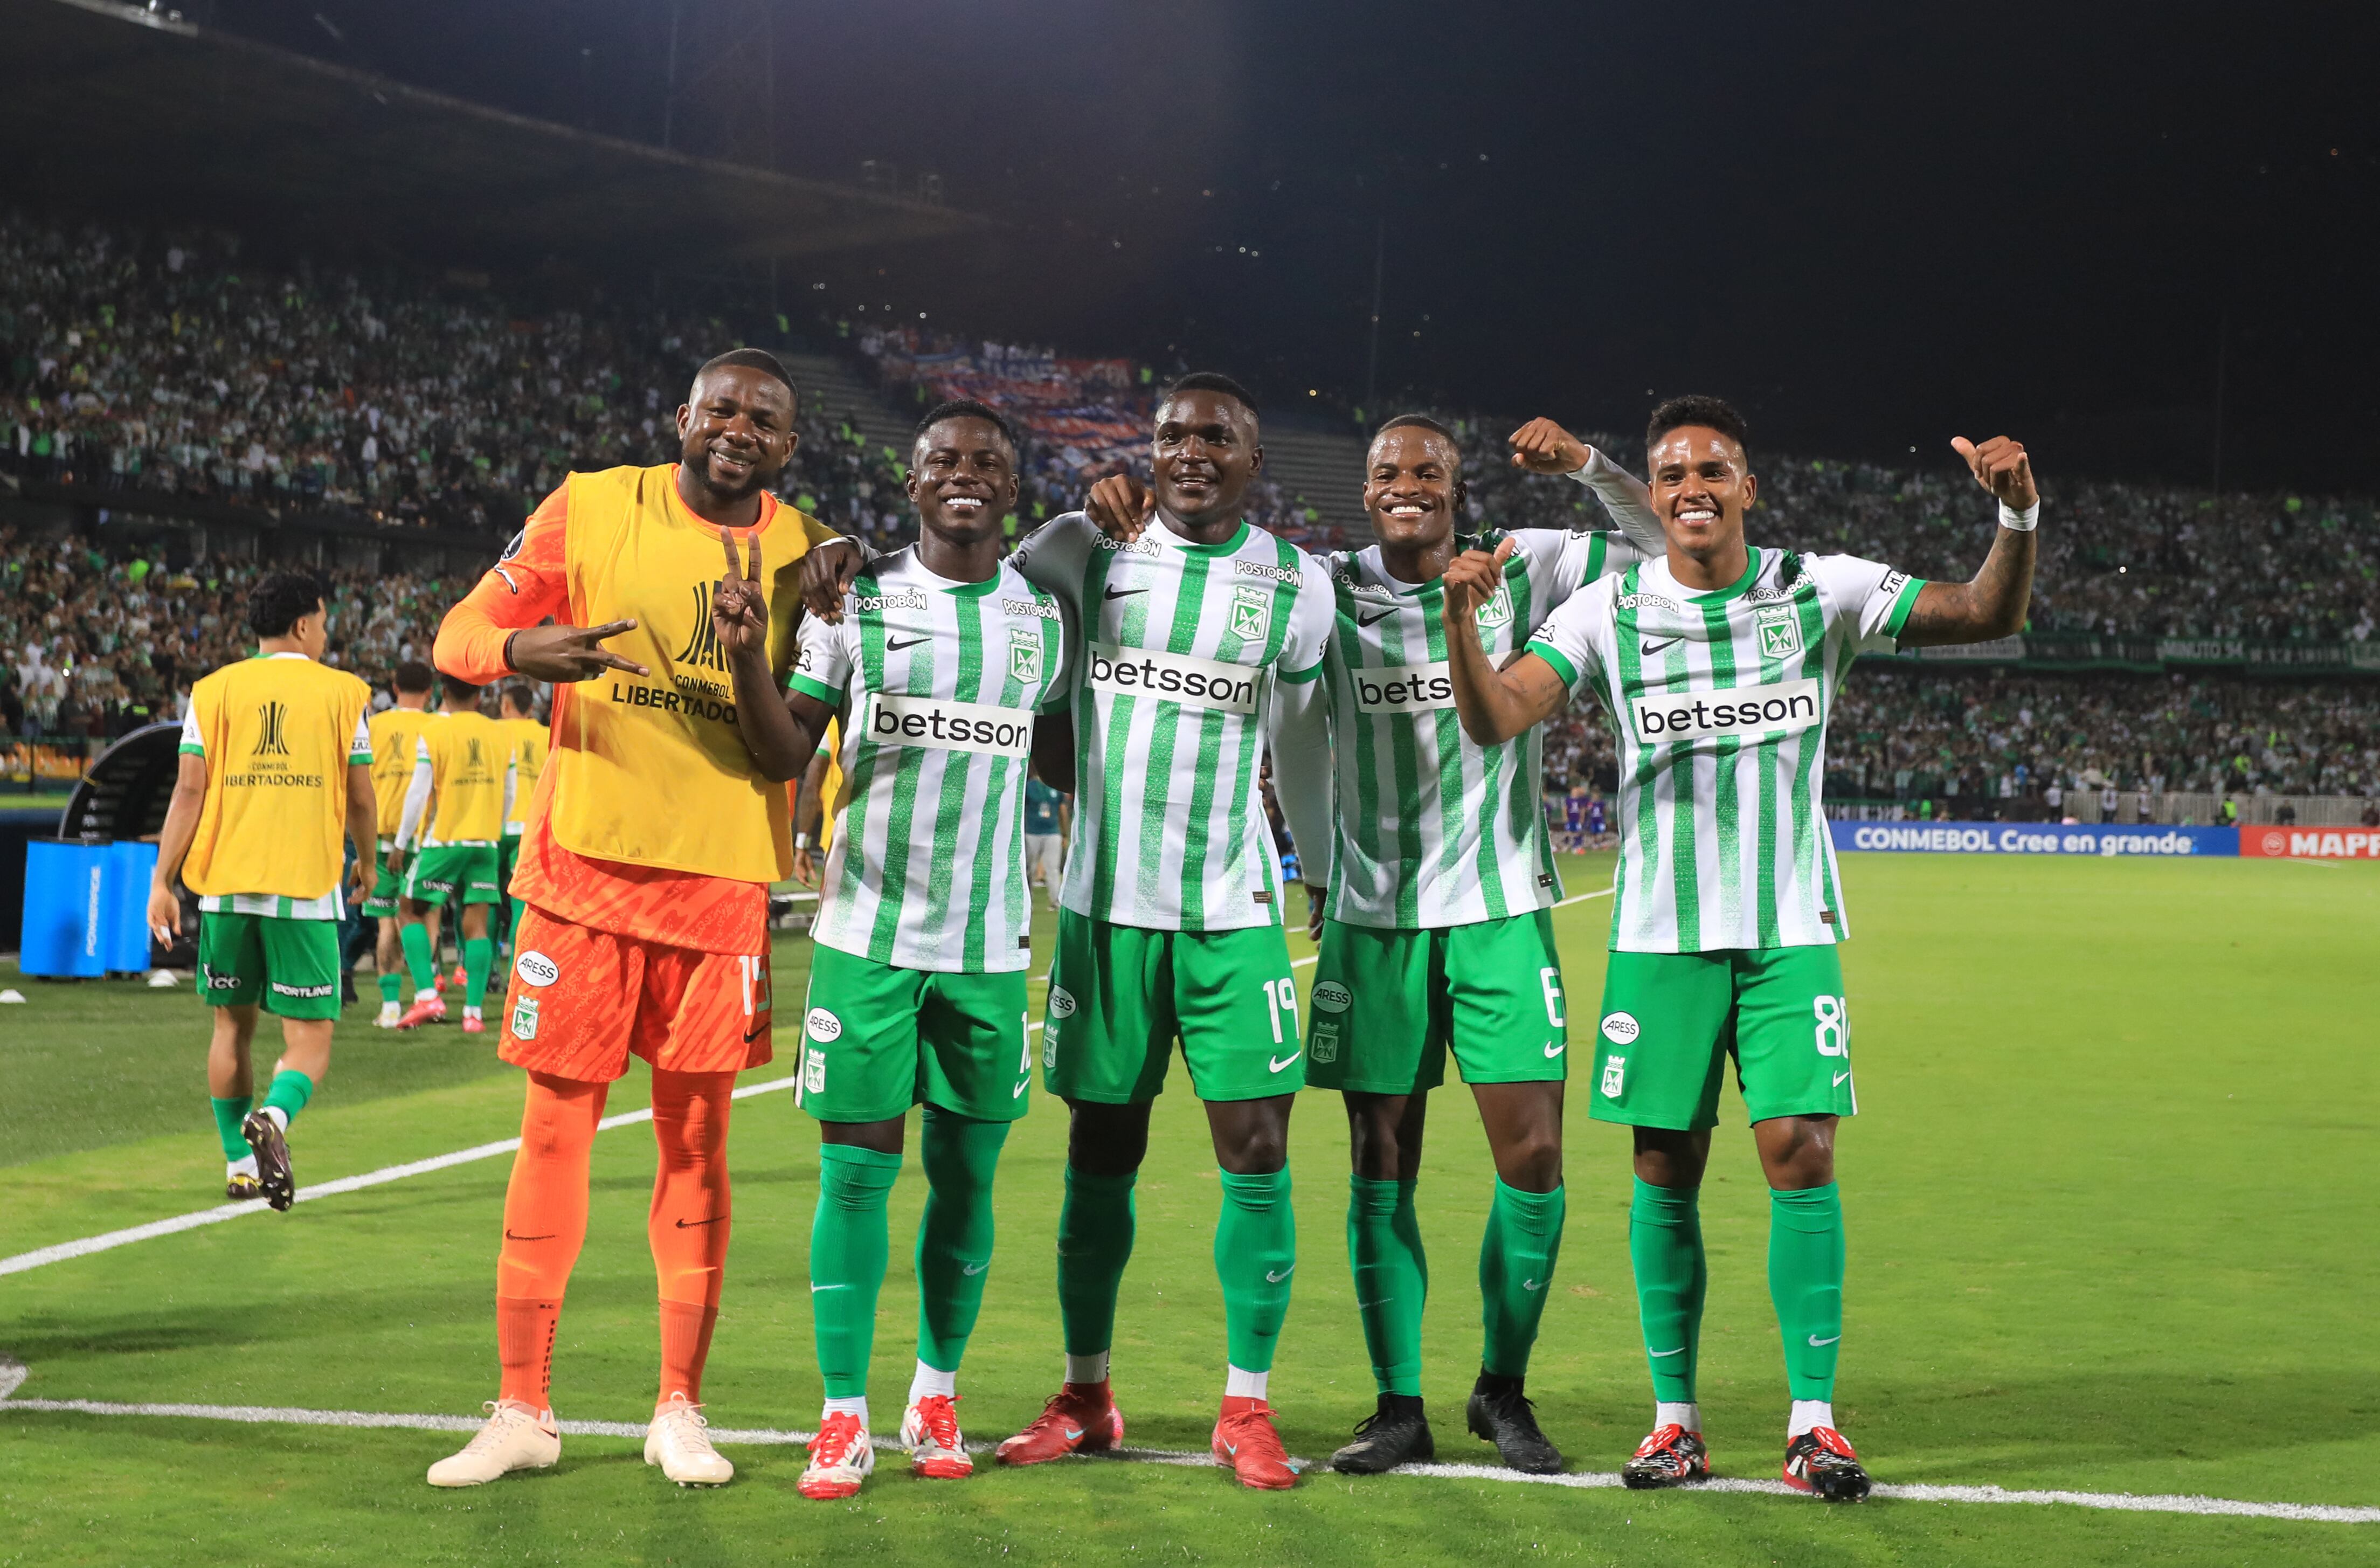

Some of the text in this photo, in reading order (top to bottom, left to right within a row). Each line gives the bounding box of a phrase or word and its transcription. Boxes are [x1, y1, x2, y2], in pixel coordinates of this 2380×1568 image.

[675, 675, 730, 699] CONMEBOL
[1091, 651, 1253, 704] betsson
[1358, 674, 1452, 704] bets
[612, 683, 738, 724] LIBERTADO
[1641, 695, 1814, 734] betsson
[874, 703, 1027, 748] betsson
[225, 775, 322, 787] IBERTADORES
[1854, 827, 2192, 856] CONMEBOL Cree en grande
[519, 957, 555, 978] ARESS
[272, 982, 333, 997] SPORTLINE
[1313, 988, 1349, 1004] ARESS
[1263, 977, 1300, 1044] 19
[810, 1016, 838, 1034] ARESS
[1604, 1020, 1636, 1035] ARESS
